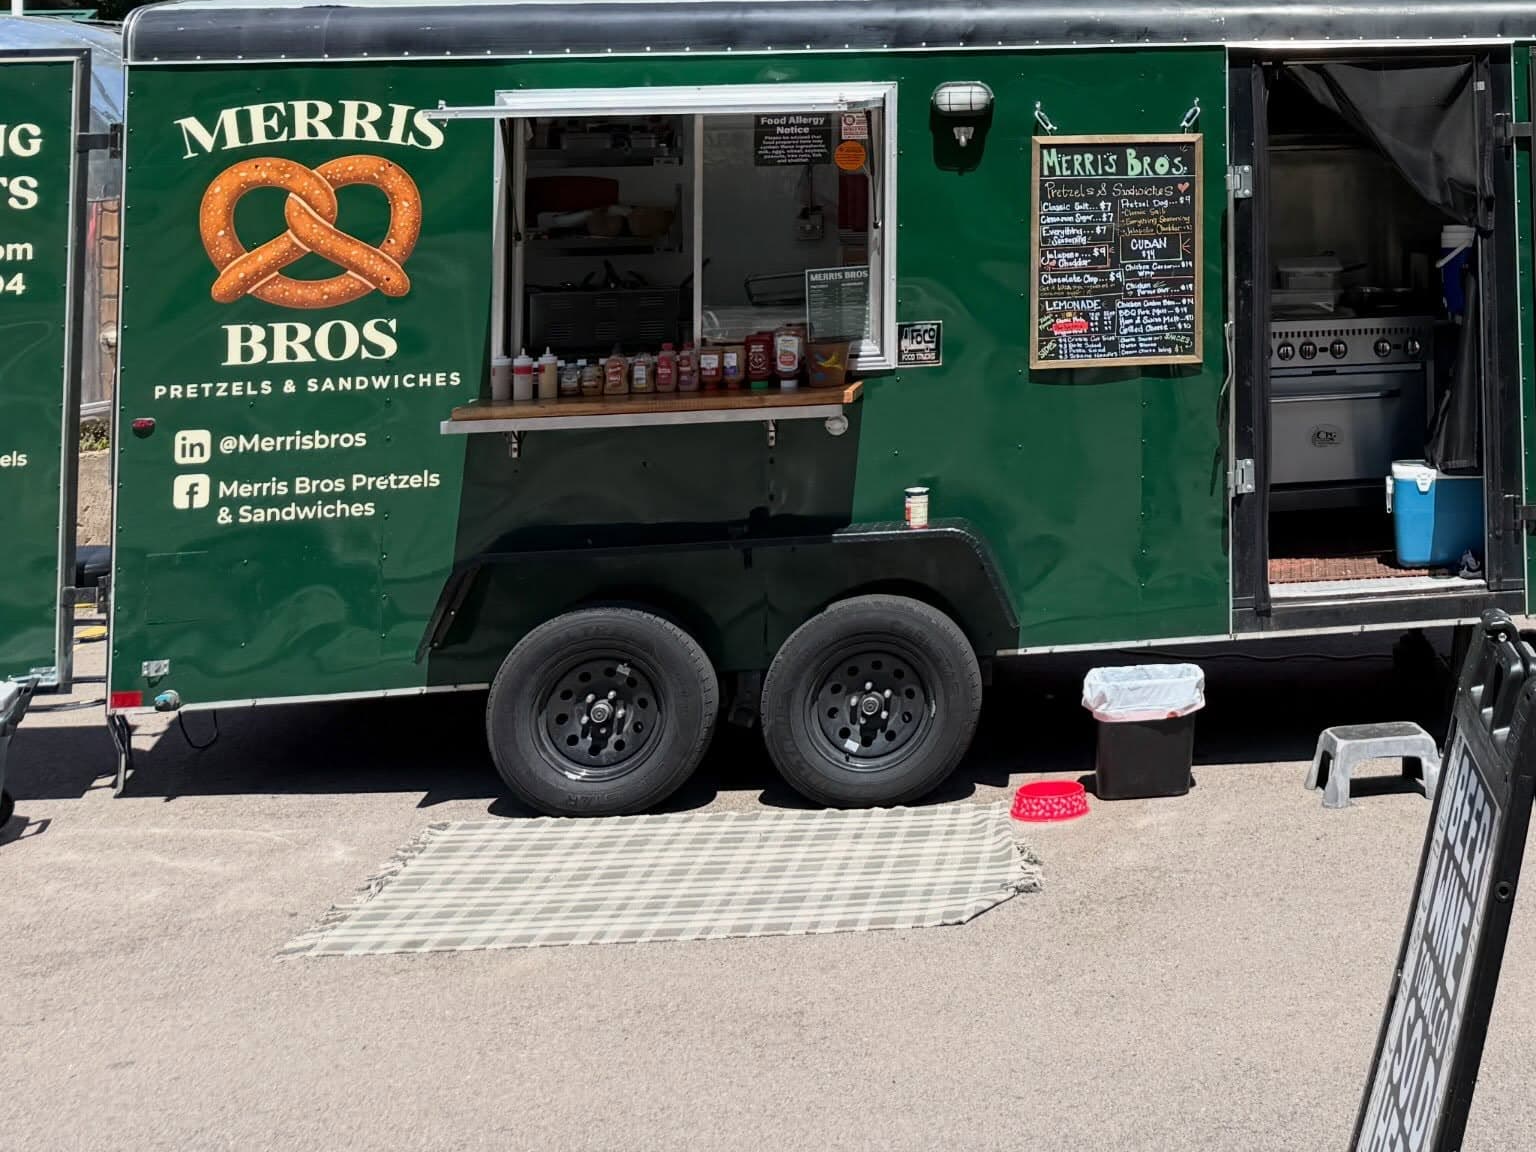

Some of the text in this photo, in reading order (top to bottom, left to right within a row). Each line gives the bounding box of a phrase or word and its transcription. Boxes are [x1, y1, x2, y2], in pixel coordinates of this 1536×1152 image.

[174, 100, 445, 159] MERRIS
[761, 115, 824, 125] Food Allergy
[776, 125, 810, 135] Notice
[1044, 181, 1095, 198] Pretzels
[1112, 183, 1174, 197] Sandwiches
[1042, 202, 1071, 211] Classic
[1130, 237, 1167, 249] CUBAN
[810, 270, 868, 282] MERRIS BROS
[1041, 273, 1082, 285] Chocolate
[1045, 299, 1102, 311] LEMONADE
[220, 318, 398, 366] BROS
[154, 372, 462, 400] PRETZELS & SANDWICHES
[219, 430, 367, 454] @Merrisbros
[218, 470, 441, 499] Merris Bros Pretzels
[217, 500, 376, 525] & Sandwiches
[1447, 753, 1491, 903] BEER
[1428, 848, 1472, 1001] WINE
[1415, 940, 1449, 1060] TOBACCO
[1393, 997, 1436, 1152] SOLD
